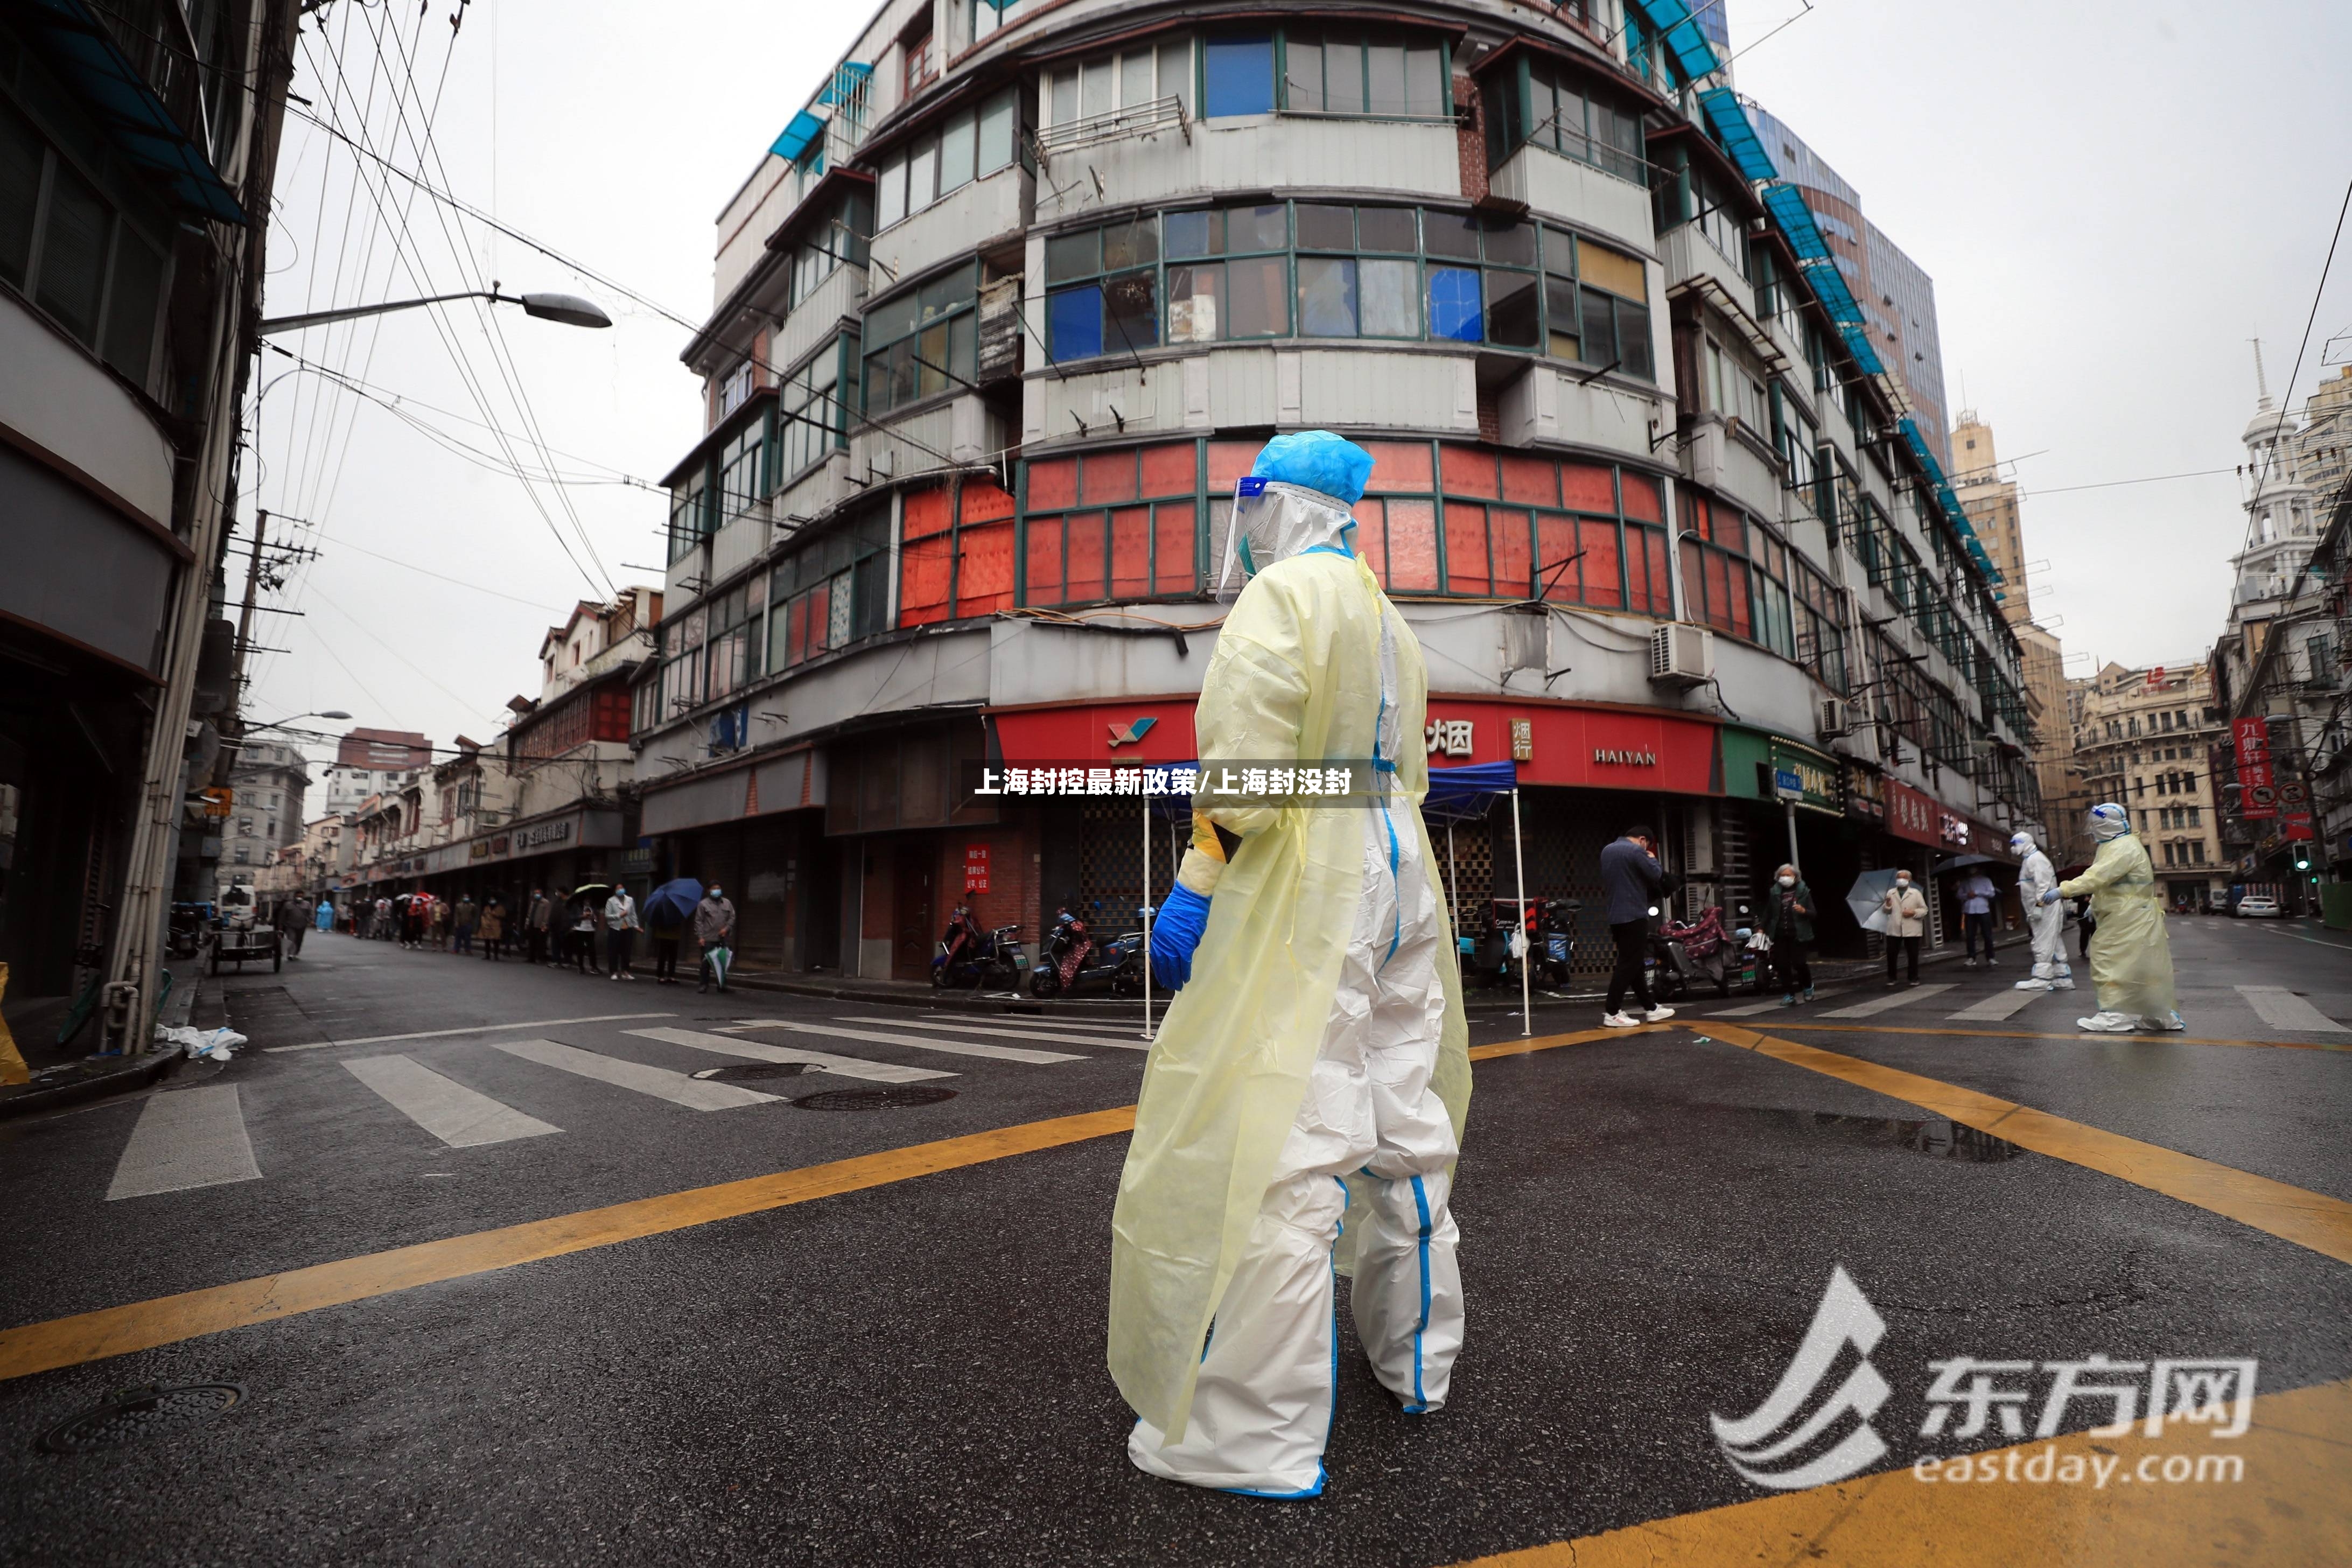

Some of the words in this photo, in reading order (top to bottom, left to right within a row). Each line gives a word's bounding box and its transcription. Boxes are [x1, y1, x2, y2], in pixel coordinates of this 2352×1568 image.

[1427, 719, 1474, 757] 烟
[1514, 722, 1532, 758] 烟行
[1595, 749, 1656, 765] HAIYAN
